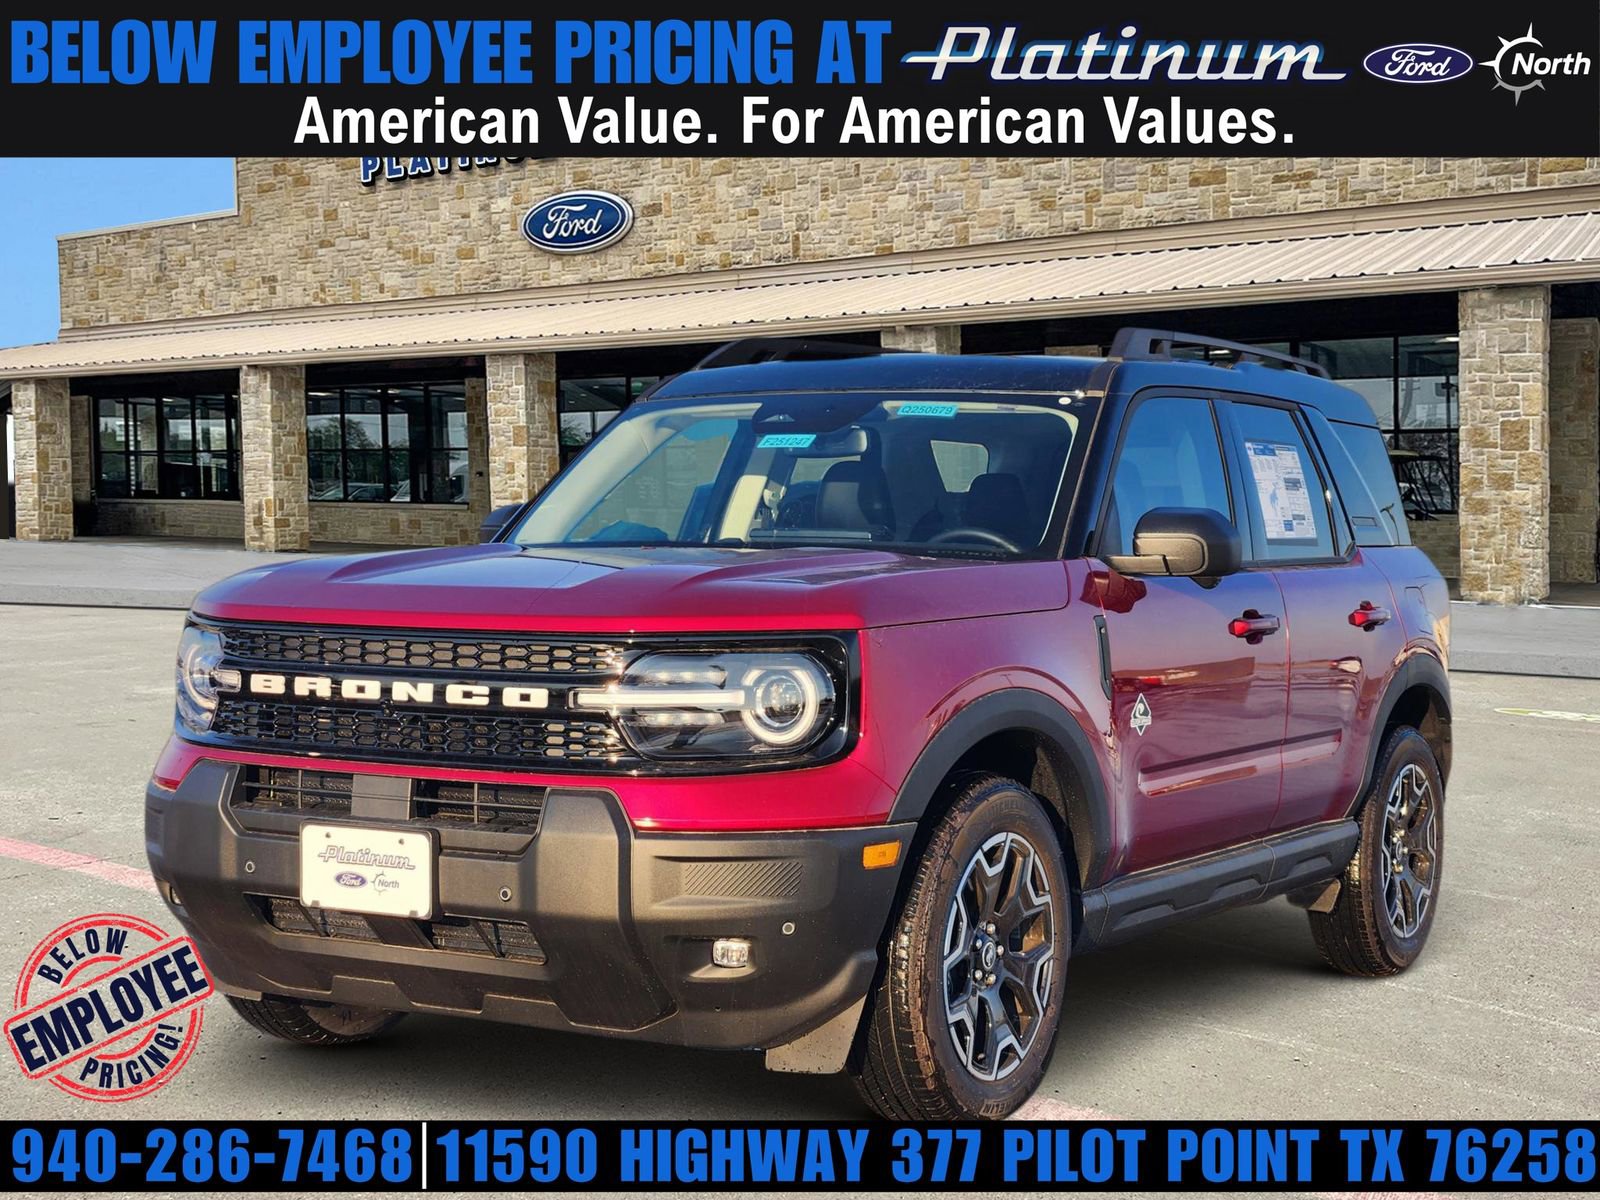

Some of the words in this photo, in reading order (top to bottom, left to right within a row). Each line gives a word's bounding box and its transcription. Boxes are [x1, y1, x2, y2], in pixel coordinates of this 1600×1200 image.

[542, 203, 603, 239] Ford
[902, 404, 953, 415] Q250679
[250, 673, 550, 708] BRONCO
[318, 845, 416, 870] Platinum
[339, 873, 363, 887] Ford
[377, 878, 400, 889] North
